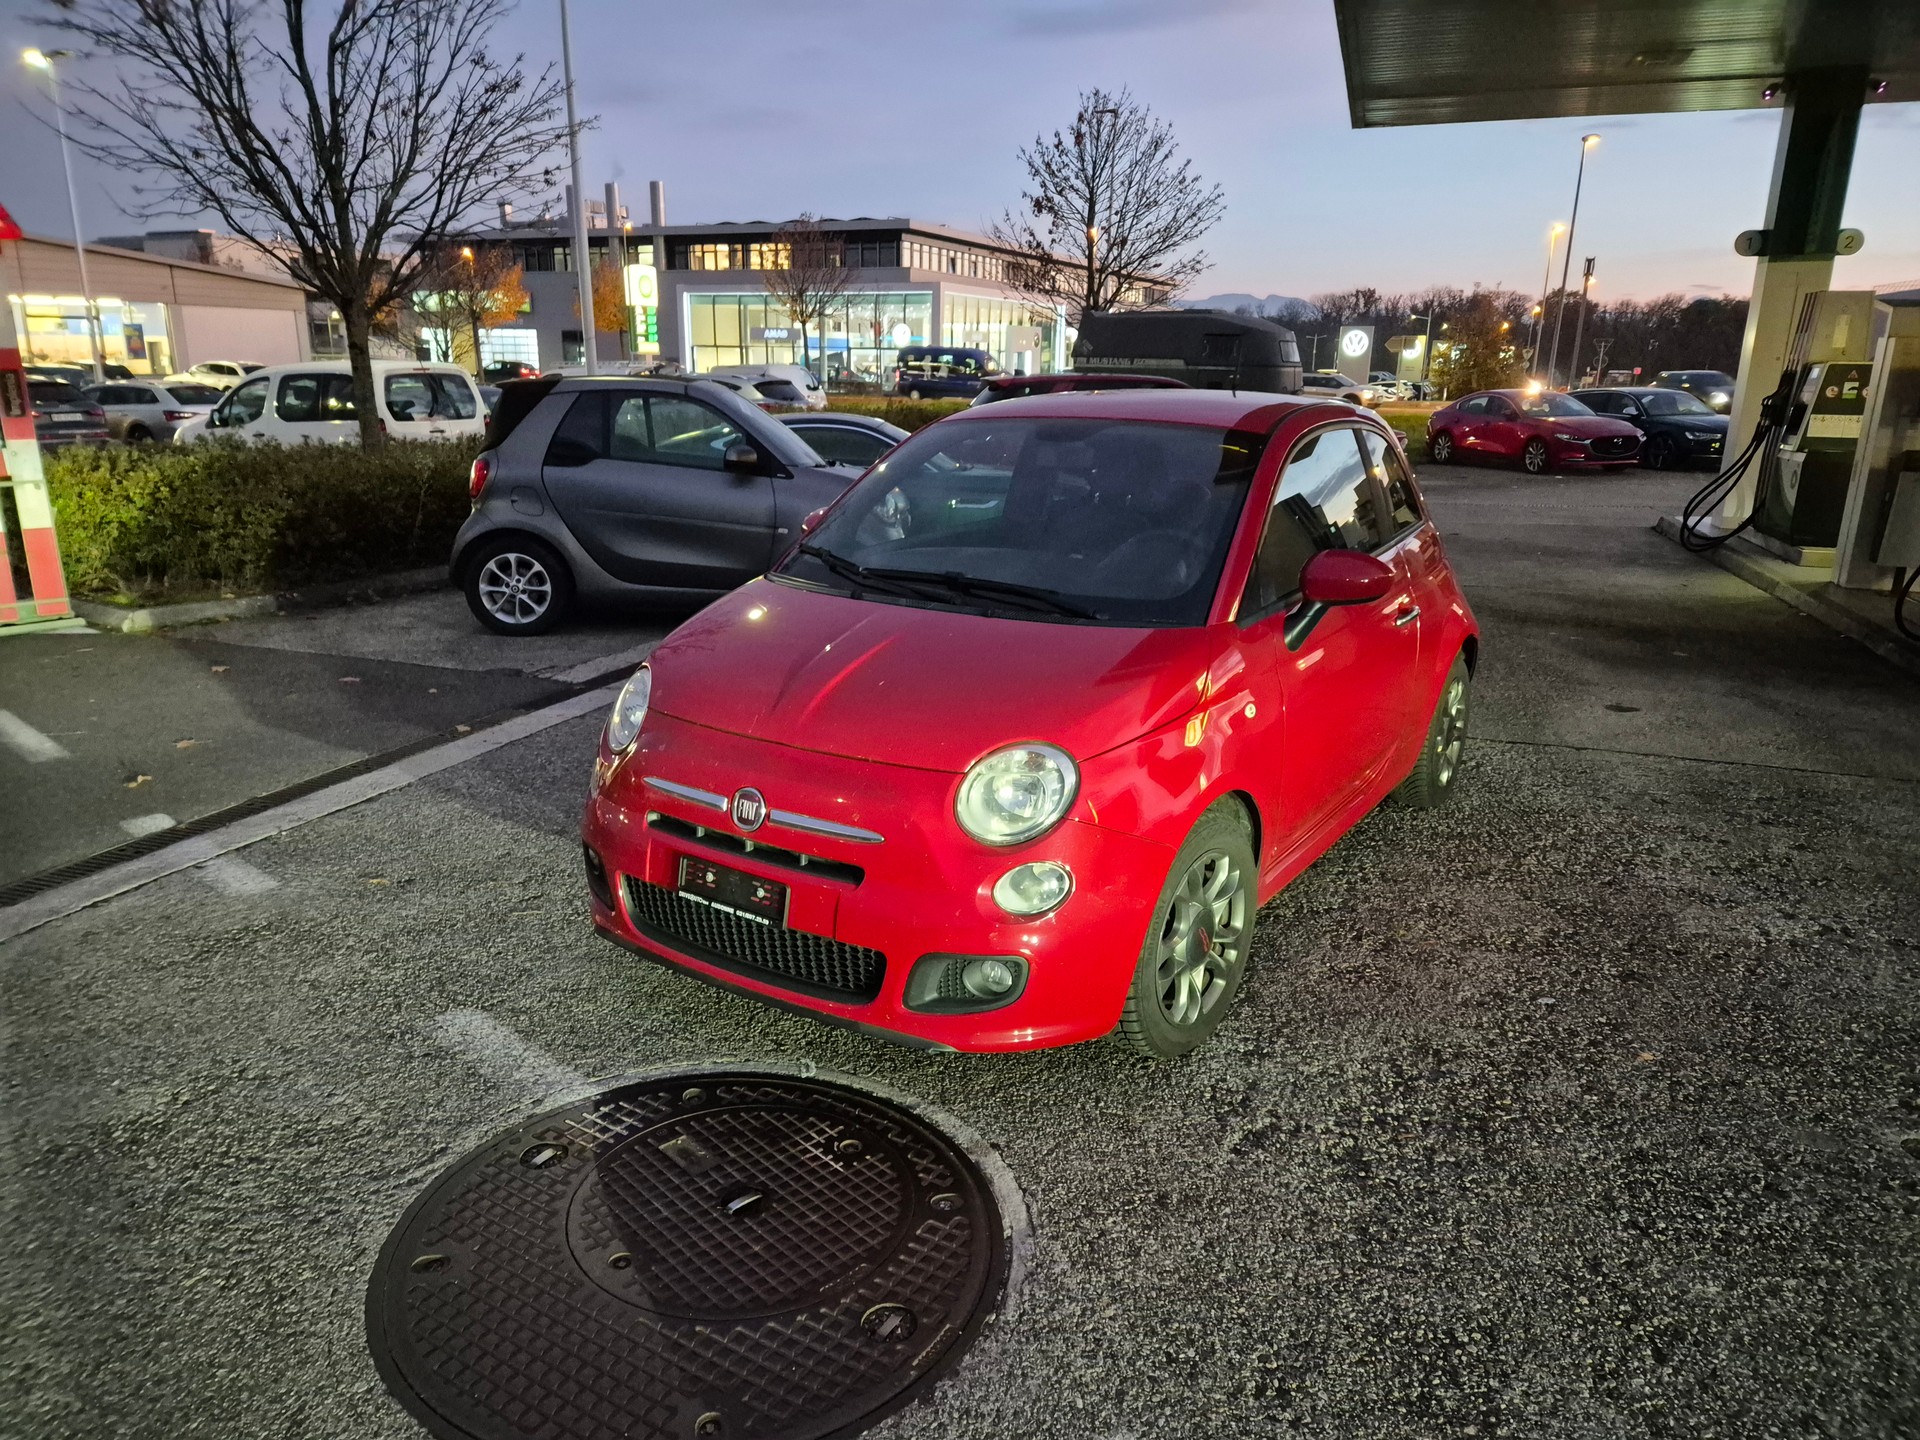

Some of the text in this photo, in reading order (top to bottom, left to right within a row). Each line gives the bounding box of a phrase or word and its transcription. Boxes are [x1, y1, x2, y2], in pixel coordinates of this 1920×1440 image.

[1746, 237, 1753, 250] 1
[1844, 235, 1855, 249] 2
[738, 799, 758, 820] FIAT
